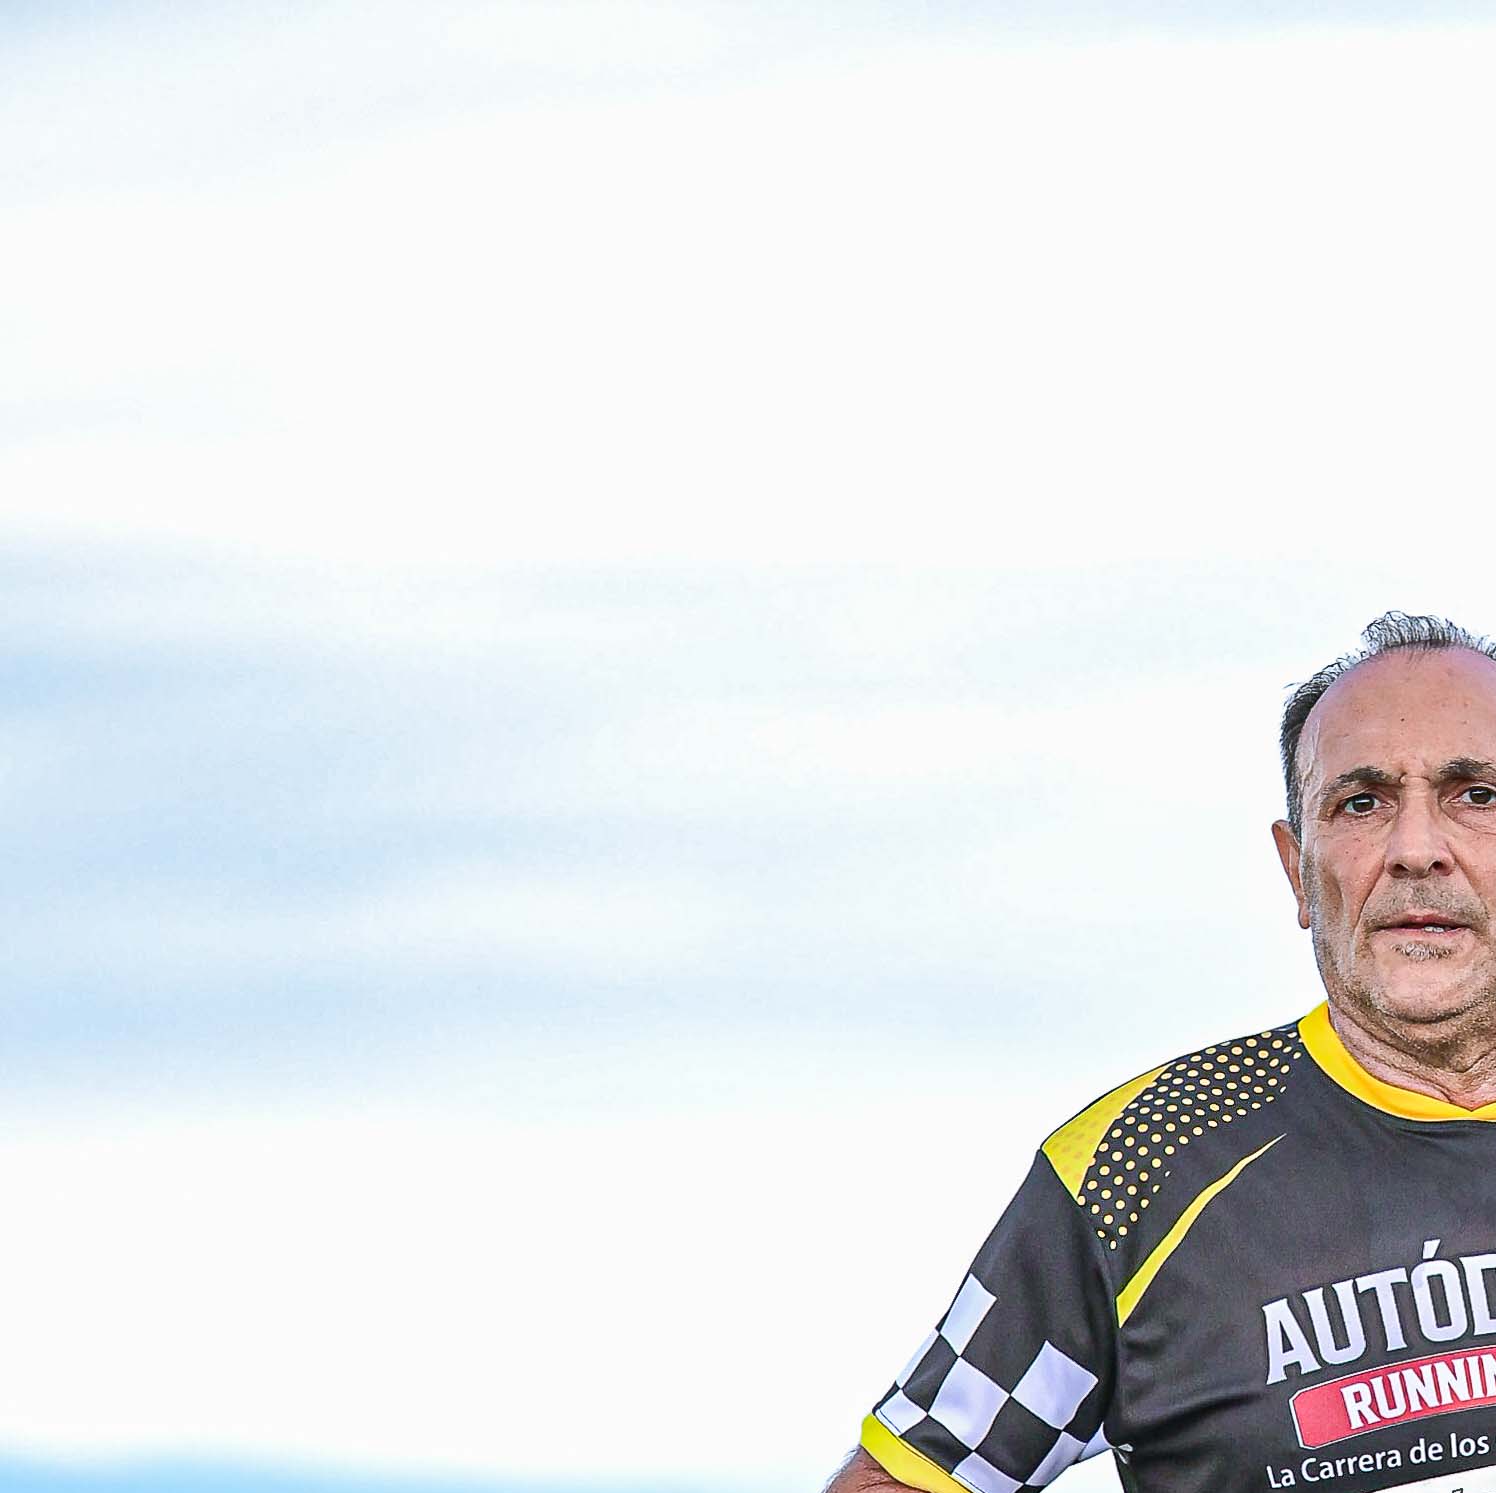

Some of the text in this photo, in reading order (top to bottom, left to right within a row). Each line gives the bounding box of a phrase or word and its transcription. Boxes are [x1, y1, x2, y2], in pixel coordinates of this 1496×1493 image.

[1266, 1464, 1296, 1489] La
[1301, 1447, 1402, 1483] Carrera
[1409, 1438, 1443, 1464] de
[1451, 1432, 1489, 1458] los
